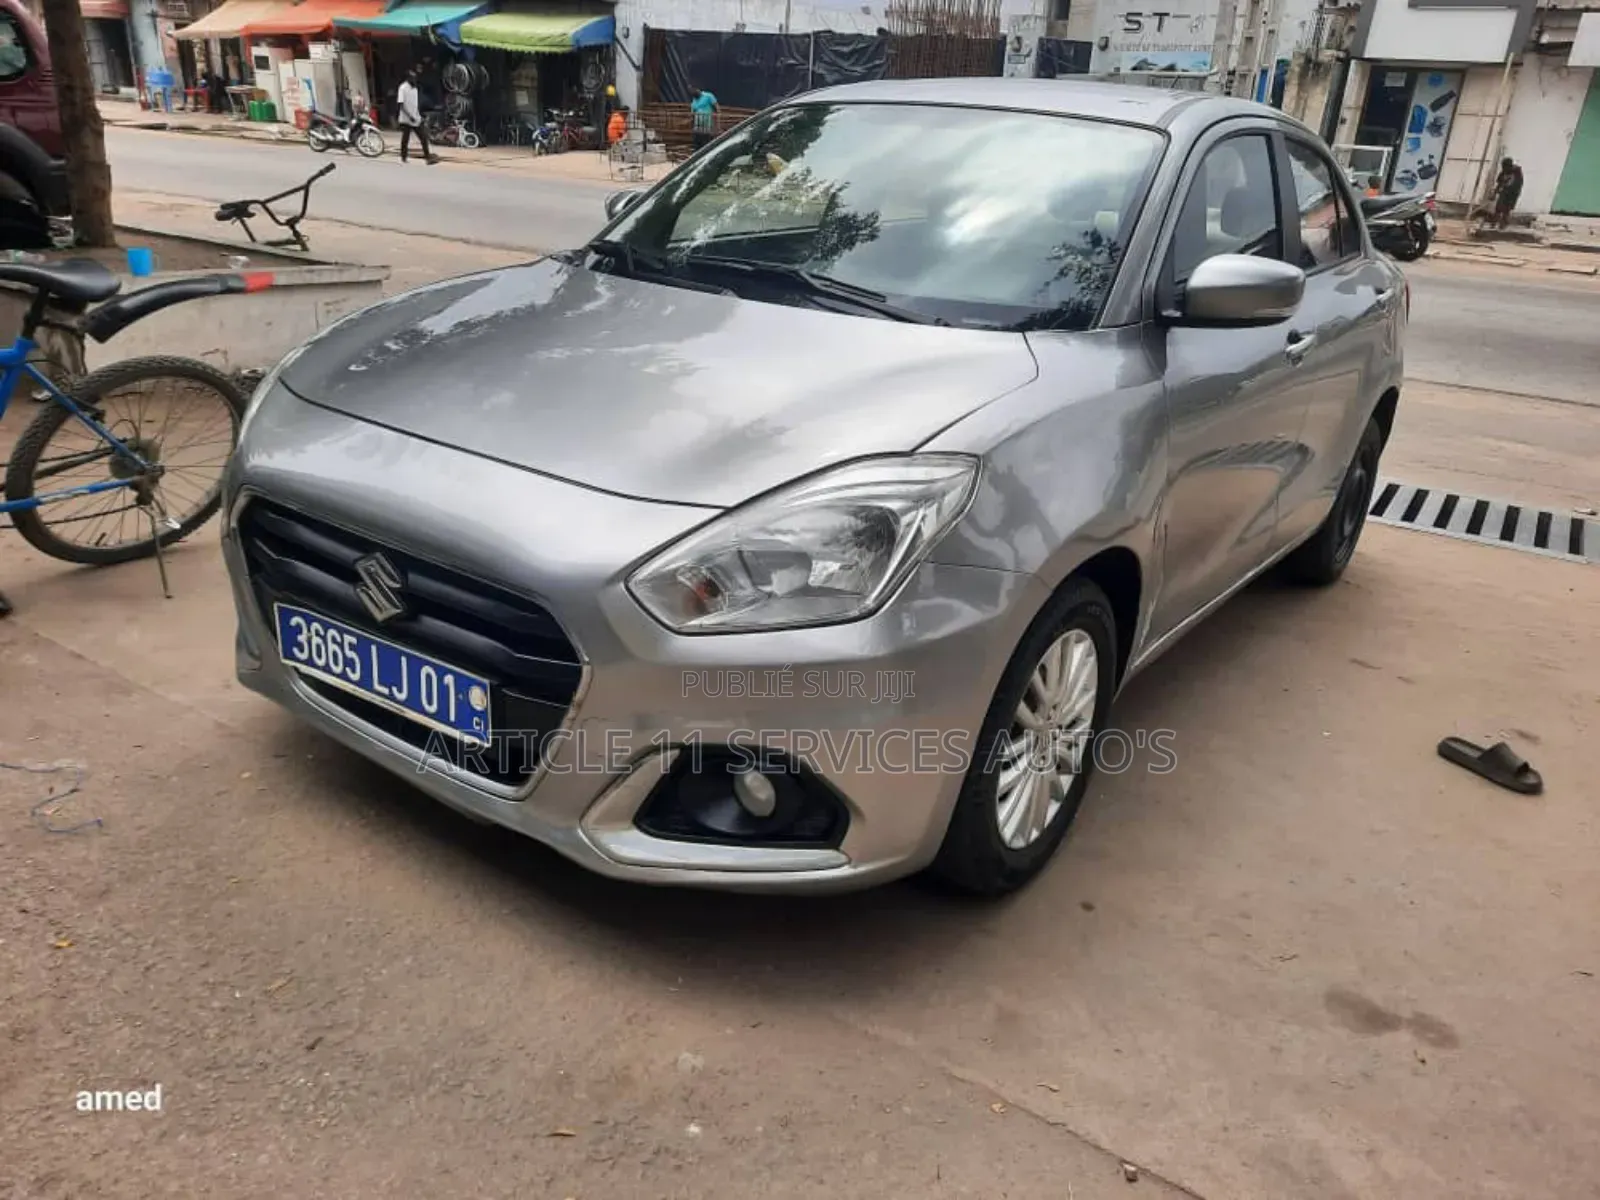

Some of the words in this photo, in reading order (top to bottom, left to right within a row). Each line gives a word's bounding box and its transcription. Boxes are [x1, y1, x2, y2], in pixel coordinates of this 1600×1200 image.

[289, 616, 361, 681] 3665
[371, 644, 408, 701] LJ
[420, 665, 456, 722] 01
